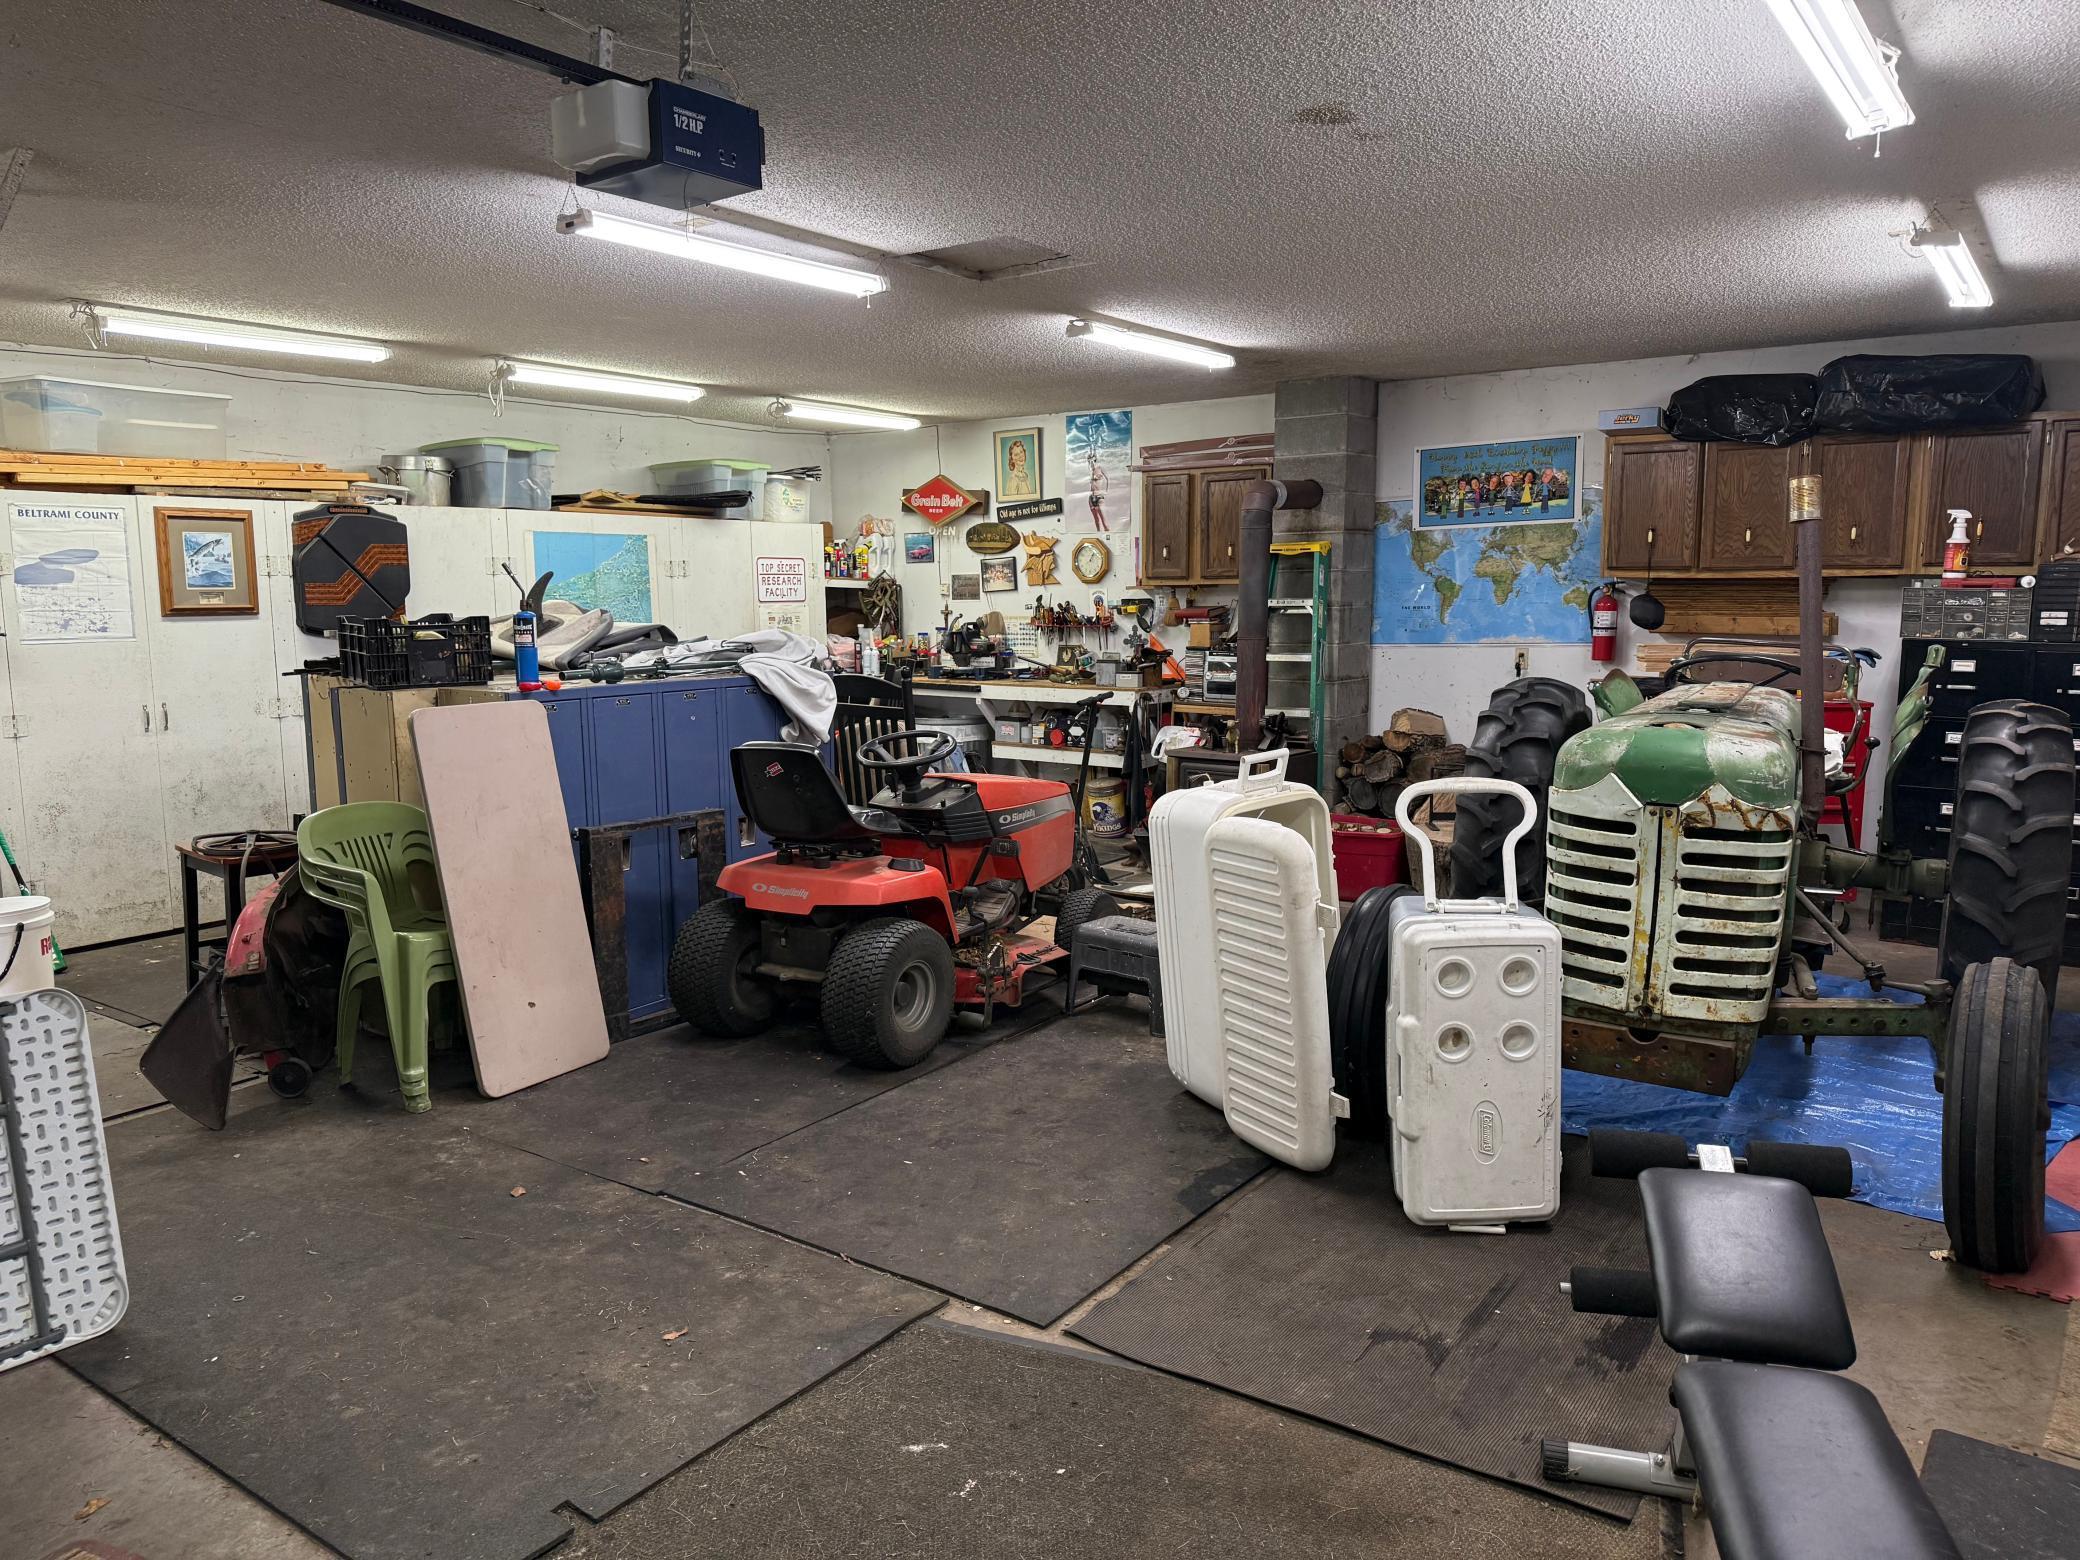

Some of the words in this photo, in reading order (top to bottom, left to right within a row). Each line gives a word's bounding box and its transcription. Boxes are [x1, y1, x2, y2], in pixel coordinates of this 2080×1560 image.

[673, 113, 689, 131] 1/2
[1614, 414, 1640, 423] Jerky
[911, 493, 941, 507] Grain
[941, 493, 964, 507] Belt
[17, 508, 71, 519] BELTRAMI
[74, 510, 119, 520] COUNTY
[1000, 509, 1008, 518] Old
[1009, 509, 1017, 519] age
[1017, 507, 1022, 517] is
[1022, 507, 1030, 516] not
[1031, 505, 1039, 514] for
[1039, 503, 1057, 513] Wimps
[928, 526, 957, 537] OPEN
[761, 563, 774, 573] TOP
[776, 563, 801, 573] SECRET
[761, 576, 802, 586] RESEARCH
[765, 587, 798, 597] FACILITY
[1011, 809, 1036, 822] Simplicity
[768, 885, 809, 900] Simplicity
[1482, 1113, 1492, 1152] Coleman
